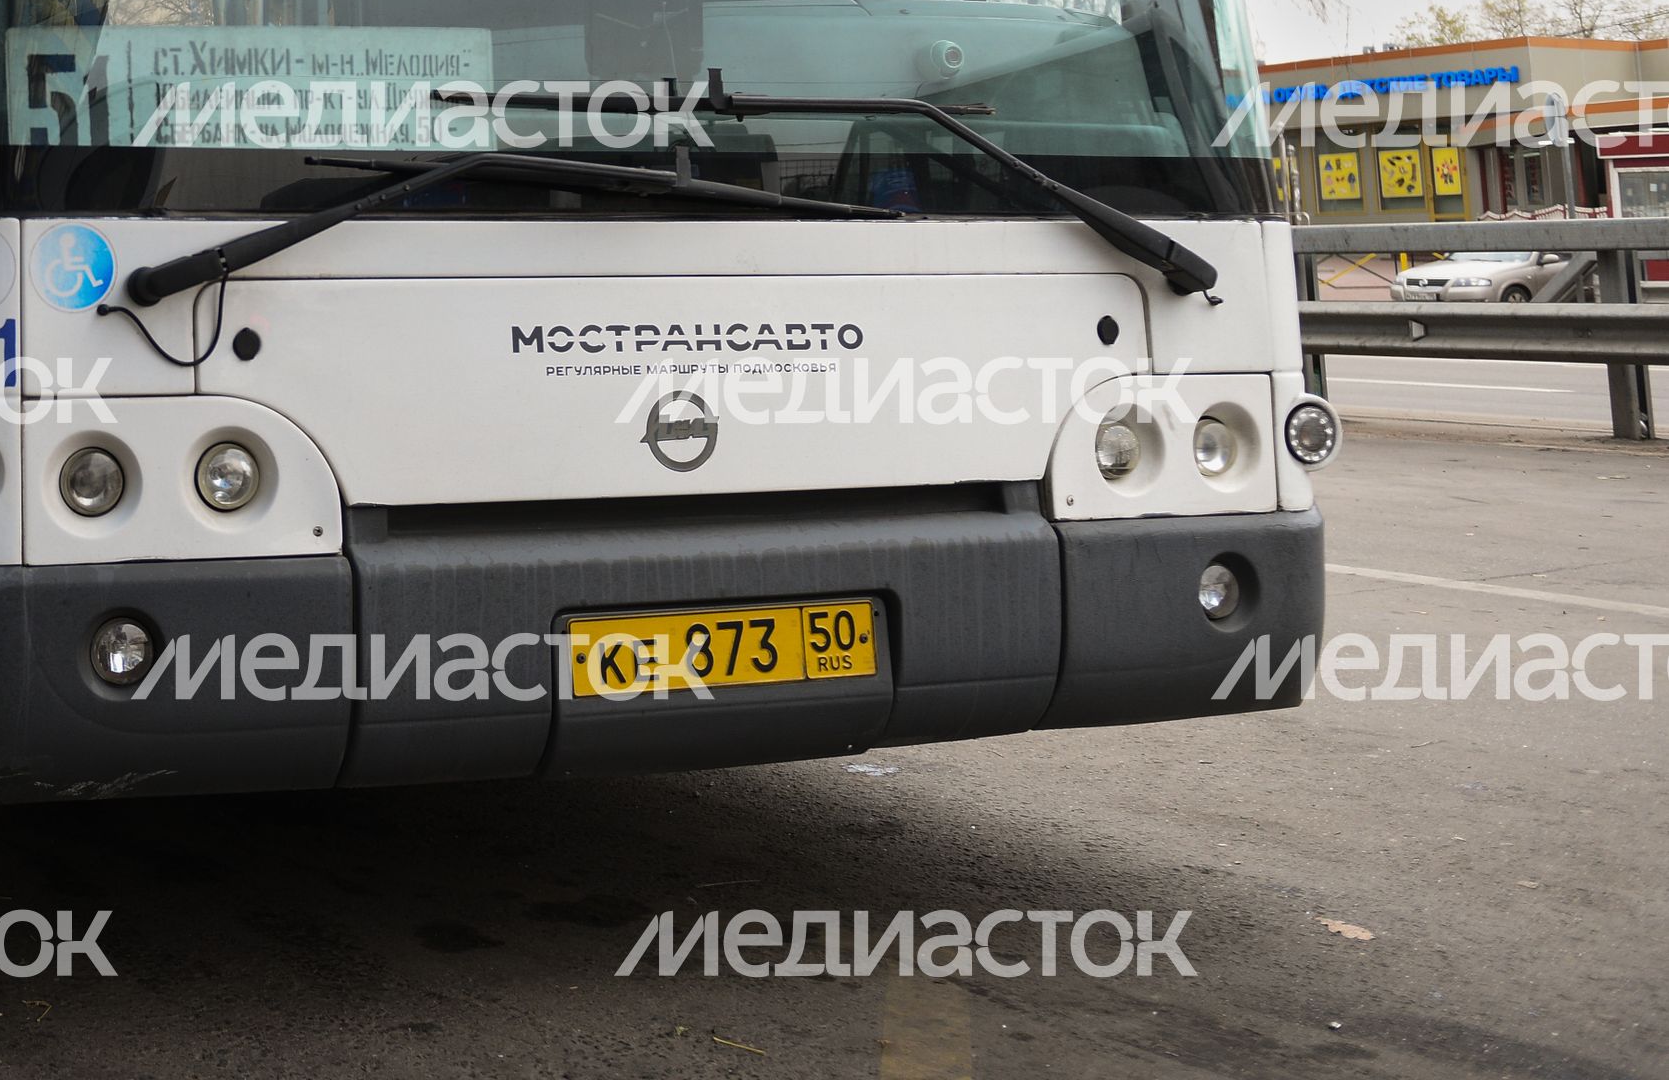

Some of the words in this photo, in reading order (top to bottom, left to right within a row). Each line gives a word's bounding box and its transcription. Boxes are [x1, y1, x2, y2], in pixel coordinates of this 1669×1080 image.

[1338, 74, 1428, 100] ДЕТСКИЕ
[1430, 66, 1520, 89] ТОВАРЫ
[26, 54, 110, 146] 51
[511, 323, 864, 354] МОСТРАНСАВТО
[545, 365, 642, 377] РЕГУЛЯРНЫЕ
[646, 363, 730, 375] МАРШРУТЫ
[733, 362, 838, 376] ПОДМОСКОВЬЯ
[684, 618, 779, 679] 873
[808, 609, 856, 653] 50
[818, 655, 853, 672] RUS
